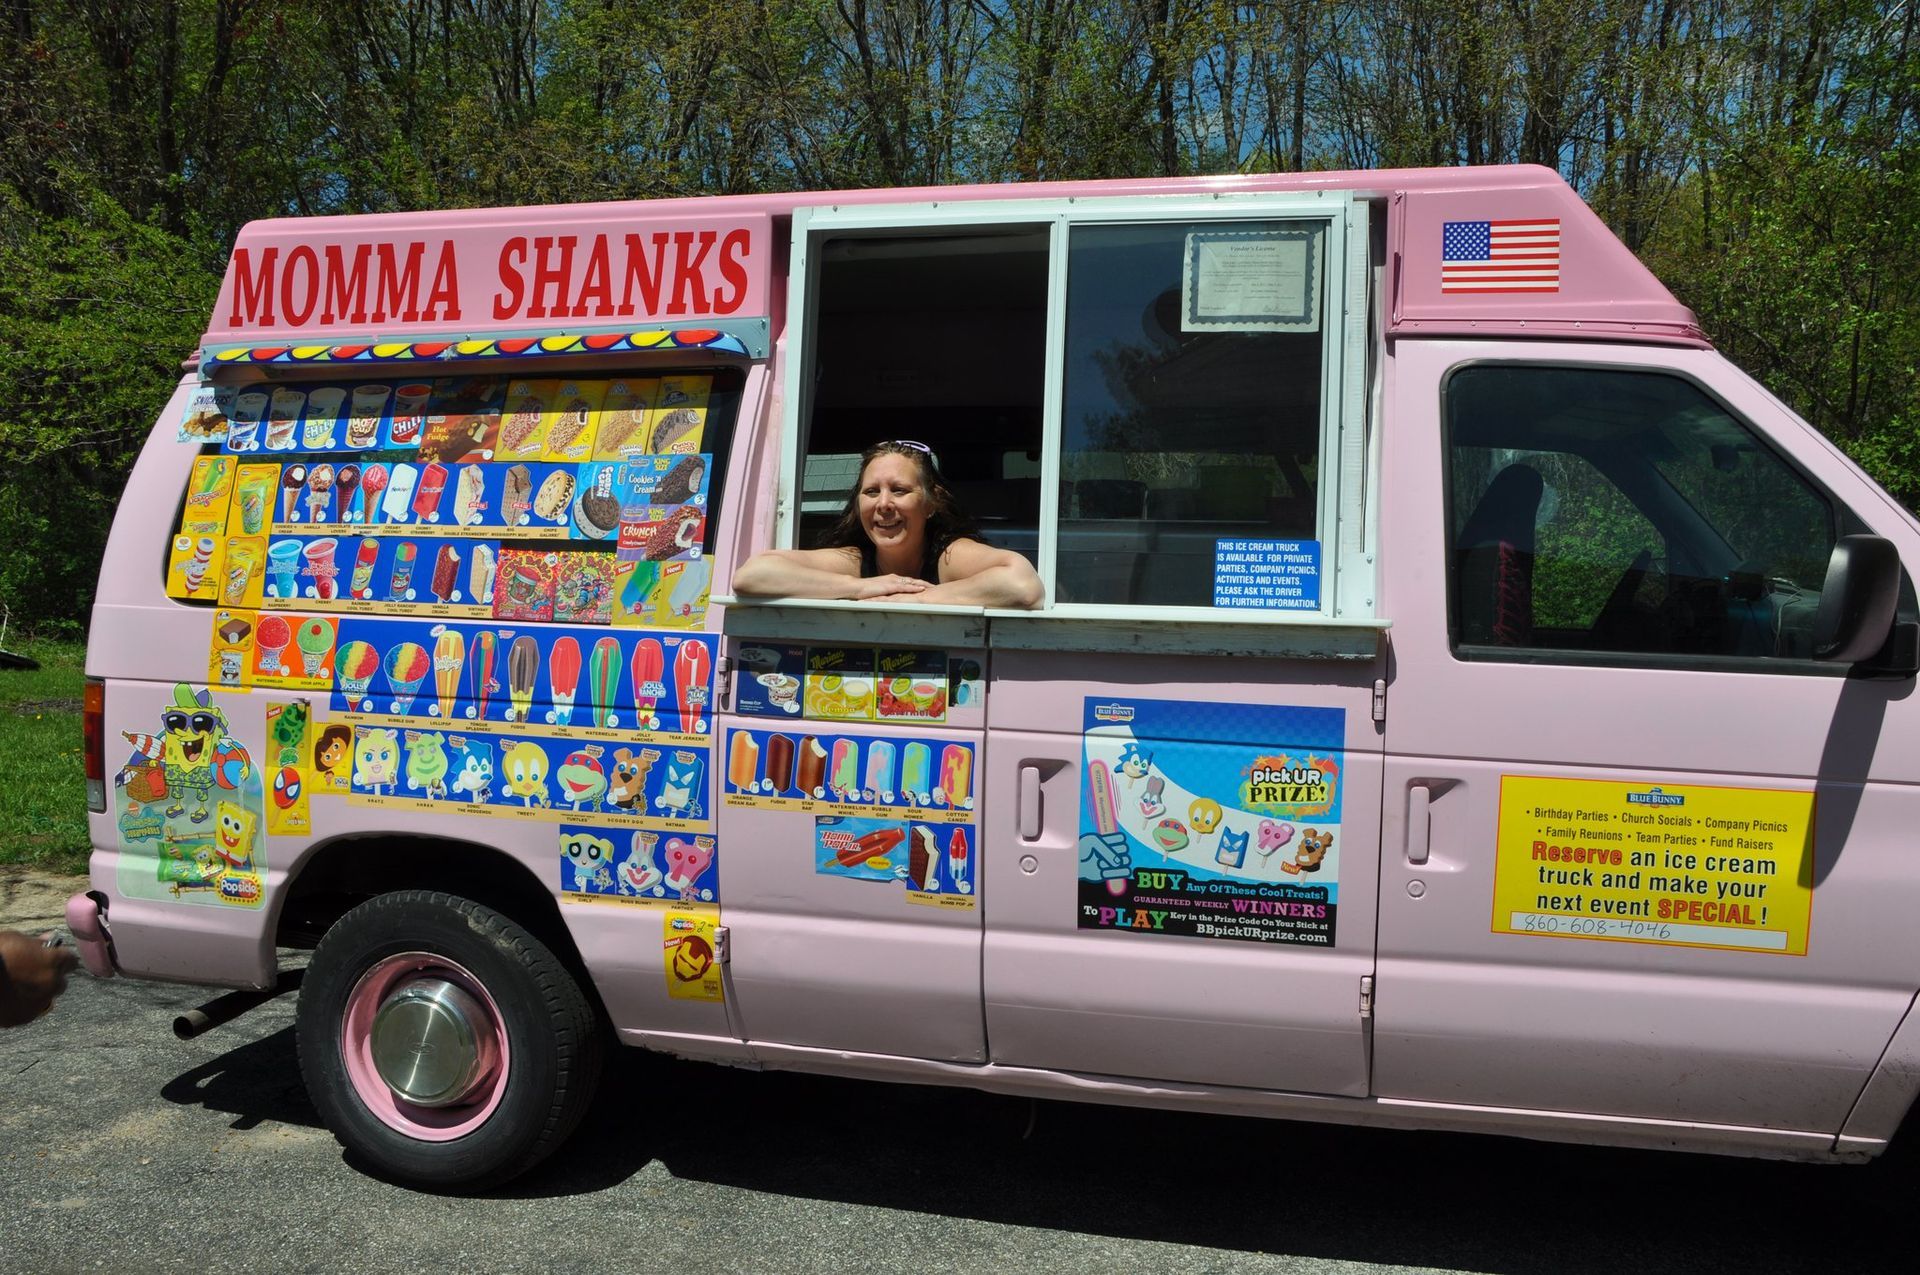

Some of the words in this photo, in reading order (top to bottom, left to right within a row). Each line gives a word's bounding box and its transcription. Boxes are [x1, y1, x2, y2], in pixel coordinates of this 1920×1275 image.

[229, 240, 461, 328] MOMMA
[492, 229, 751, 319] SHANKS
[628, 474, 654, 484] Cookies
[634, 485, 655, 494] Cream
[623, 526, 657, 536] CRUNCH
[1218, 542, 1233, 550] THIS
[1236, 542, 1247, 551] ICE
[1248, 543, 1273, 551] CREAM
[1276, 543, 1299, 552] TRUCK
[1226, 554, 1263, 562] AVAILABLE
[1267, 554, 1281, 562] FOR
[1284, 554, 1312, 563] PRIVATE
[1217, 564, 1248, 574] PARTIES,
[1250, 565, 1285, 574] COMPANY
[1287, 566, 1318, 575] PICNICS,
[1216, 576, 1254, 584] ACTIVITIES
[1256, 576, 1271, 584] AND
[1273, 577, 1302, 585] EVENTS.
[1216, 587, 1242, 595] PLEASE
[1260, 587, 1273, 596] THE
[1276, 588, 1302, 596] DRIVER
[1216, 597, 1230, 605] FOR
[1232, 598, 1264, 606] FURTHER
[1266, 598, 1317, 608] INFORMATION.
[1250, 786, 1326, 802] PRIZE!
[1630, 794, 1651, 802] BLUE
[1652, 795, 1682, 804] BUNNY
[1534, 808, 1573, 822] Birthday
[1576, 810, 1608, 822] Parties
[1621, 812, 1654, 824] Church
[1658, 815, 1692, 827] Socials
[1705, 817, 1750, 832] Company
[1753, 820, 1788, 832] Picnics
[1546, 826, 1576, 840] Family
[1580, 828, 1622, 841] Reunions
[1636, 832, 1660, 843] Team
[1664, 834, 1697, 846] Parties
[1710, 836, 1733, 848] Fund
[1737, 838, 1774, 850] Raisers
[1532, 841, 1623, 866] Reserve
[1630, 851, 1656, 867] an
[1665, 850, 1697, 870] ice
[1705, 855, 1776, 875] cream
[1281, 862, 1300, 874] New!
[221, 880, 257, 896] Popsicle
[1137, 872, 1184, 890] BUY
[1186, 883, 1207, 894] Any
[1209, 884, 1223, 893] Of
[1224, 886, 1256, 895] These
[1260, 888, 1283, 897] Cool
[1286, 890, 1324, 900] Treats!
[1538, 866, 1593, 886] truck
[1601, 872, 1640, 889] and
[1649, 875, 1708, 895] make
[1716, 880, 1767, 900] your
[1133, 896, 1191, 906] GUARANTEED
[1194, 900, 1229, 909] WEEKLY
[1232, 899, 1326, 918] WINNERS
[1536, 893, 1582, 912] next
[1590, 898, 1650, 917] event
[1084, 905, 1098, 915] To
[1099, 906, 1168, 929] PLAY
[1170, 912, 1187, 921] Key
[1214, 915, 1237, 924] Prize
[1238, 917, 1260, 925] Code
[1275, 920, 1294, 928] Your
[1296, 921, 1317, 929] Stick
[1196, 923, 1328, 942] BBpickURprize.com
[1524, 914, 1671, 939] 860-608-4046
[665, 938, 681, 948] New!
